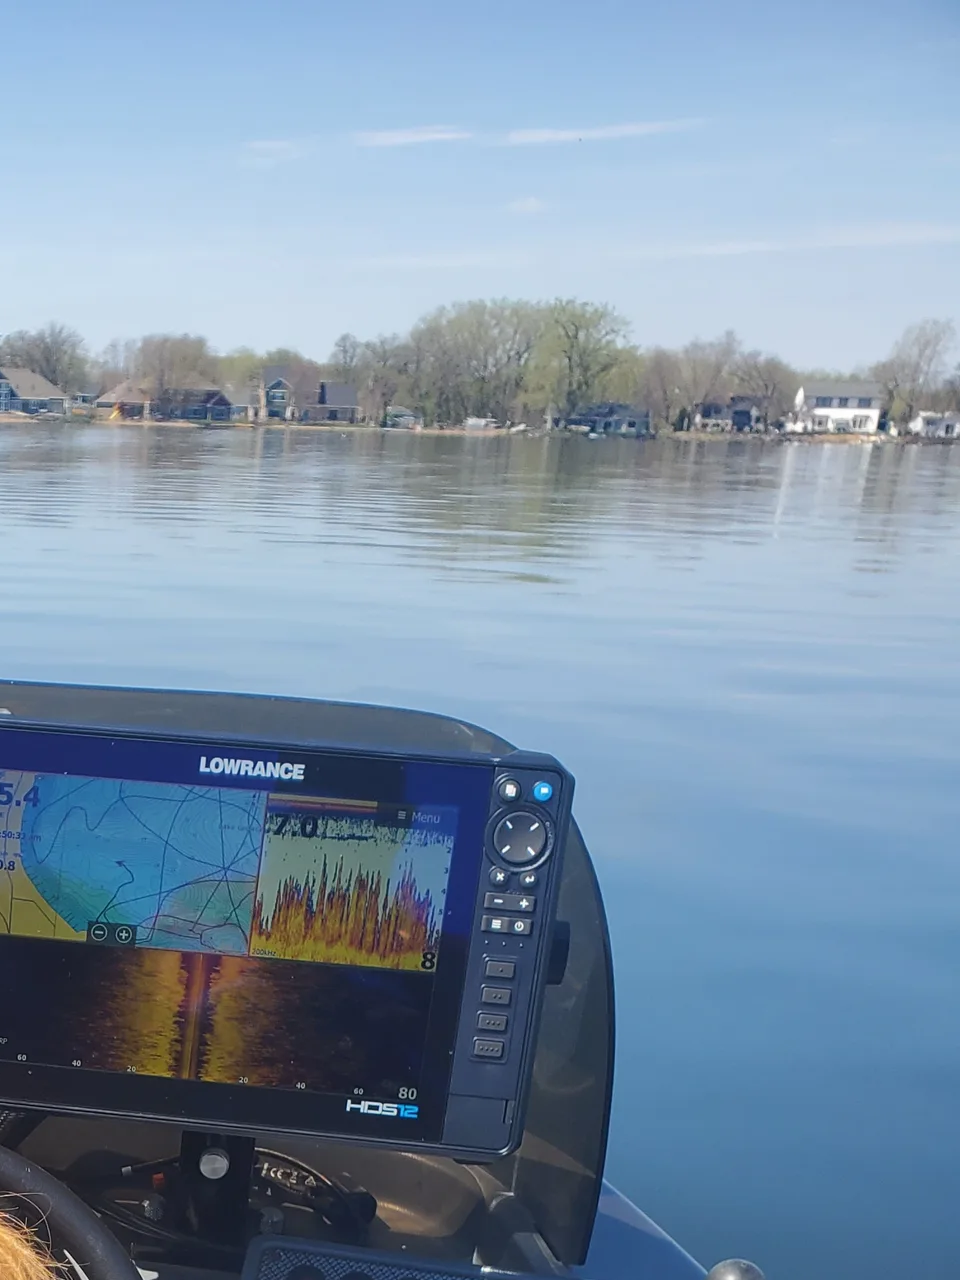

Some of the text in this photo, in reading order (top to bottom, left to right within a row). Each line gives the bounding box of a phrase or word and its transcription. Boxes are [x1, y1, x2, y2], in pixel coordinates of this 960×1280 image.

[199, 756, 306, 780] LOWRANCE
[411, 811, 441, 824] Menu
[420, 951, 436, 971] 8
[17, 1053, 28, 1062] 60
[71, 1059, 82, 1067] 40
[126, 1065, 137, 1073] 20
[238, 1076, 249, 1084] 20
[295, 1081, 306, 1090] 40
[353, 1087, 364, 1096] 60
[398, 1086, 418, 1100] 80
[346, 1099, 420, 1119] HDS12
